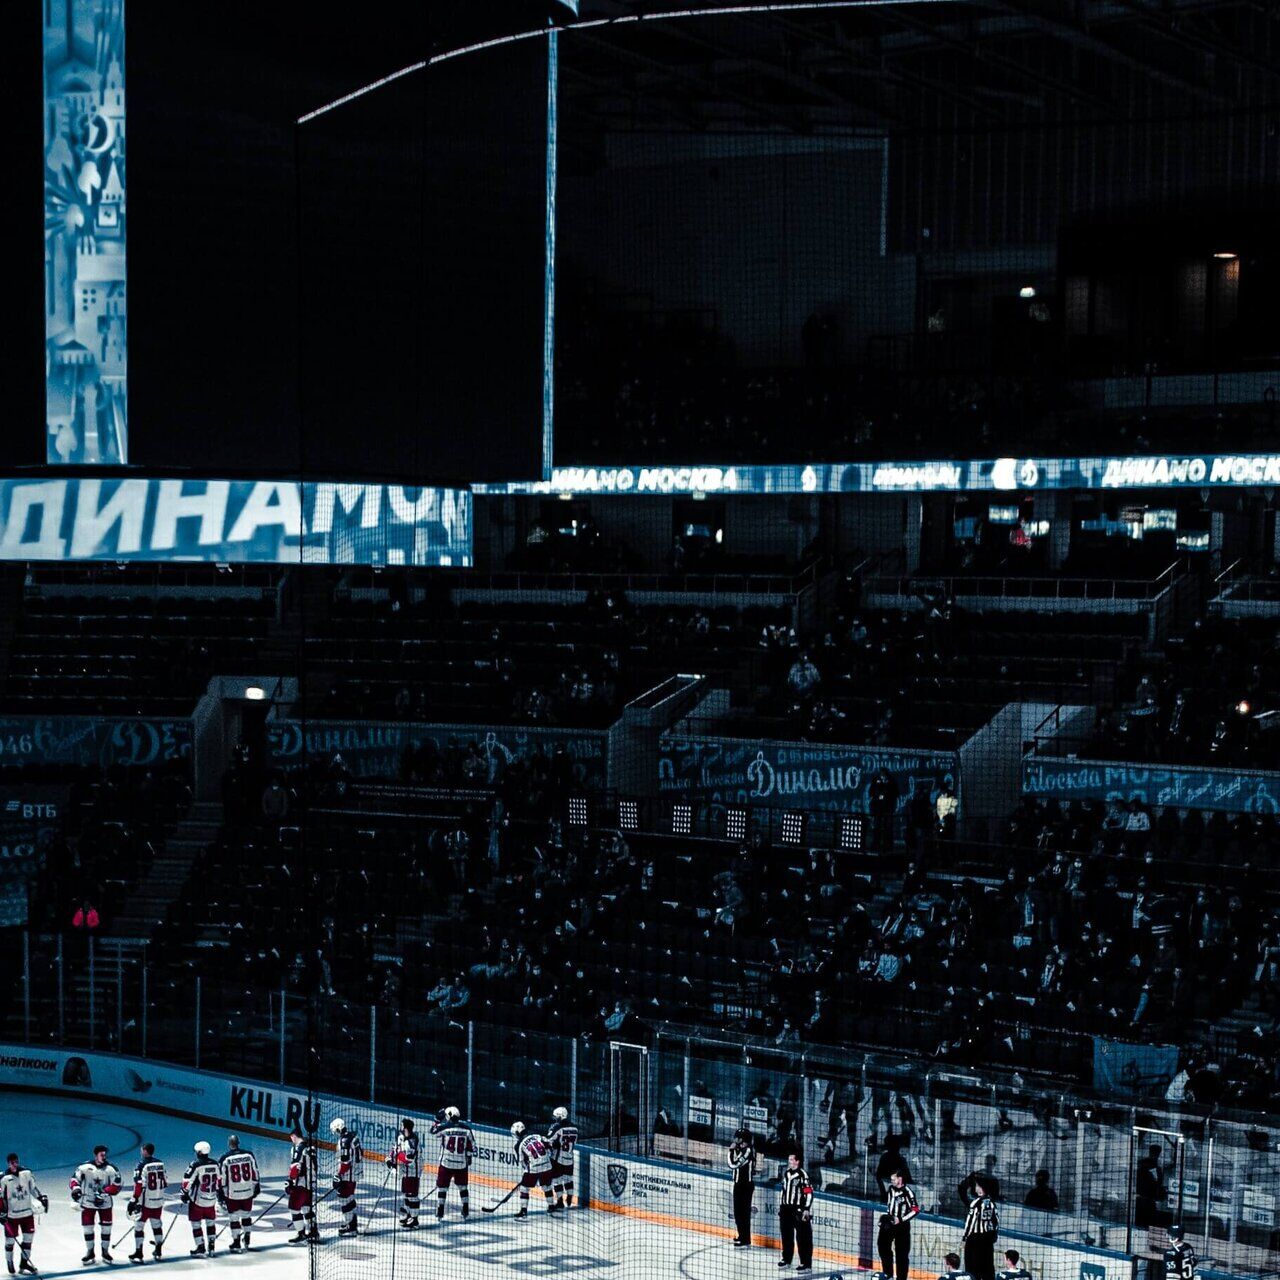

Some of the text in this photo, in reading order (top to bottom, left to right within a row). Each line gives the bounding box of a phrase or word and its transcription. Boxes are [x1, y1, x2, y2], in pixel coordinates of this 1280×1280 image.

[637, 467, 737, 490] МОСКВА
[1102, 460, 1206, 488] ДИНАМО
[747, 751, 862, 799] Динамо
[22, 804, 57, 818] ВТБ
[230, 1085, 321, 1133] KHL.RU
